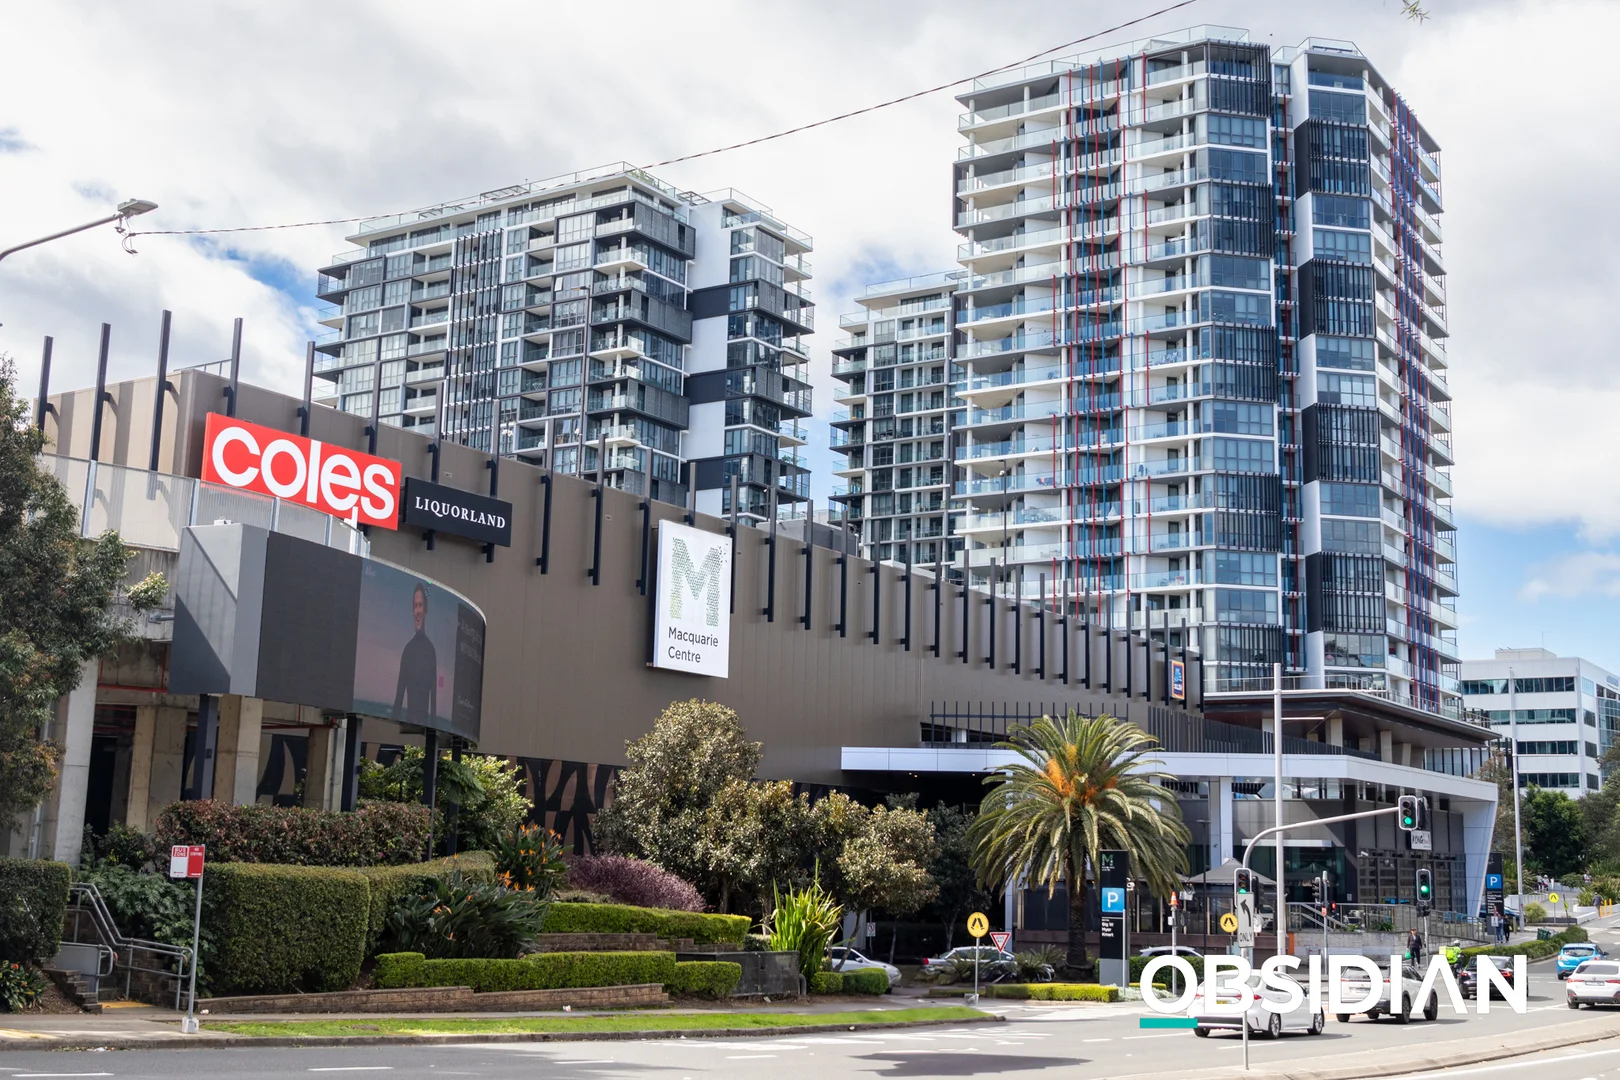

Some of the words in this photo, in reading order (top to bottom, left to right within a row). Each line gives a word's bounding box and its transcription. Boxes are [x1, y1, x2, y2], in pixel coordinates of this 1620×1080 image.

[211, 426, 395, 520] coles
[415, 496, 506, 530] LIQUORLAND
[668, 626, 719, 647] Macquarie
[668, 646, 701, 663] Centre
[1107, 892, 1118, 908] P
[1240, 932, 1252, 942] ONLY
